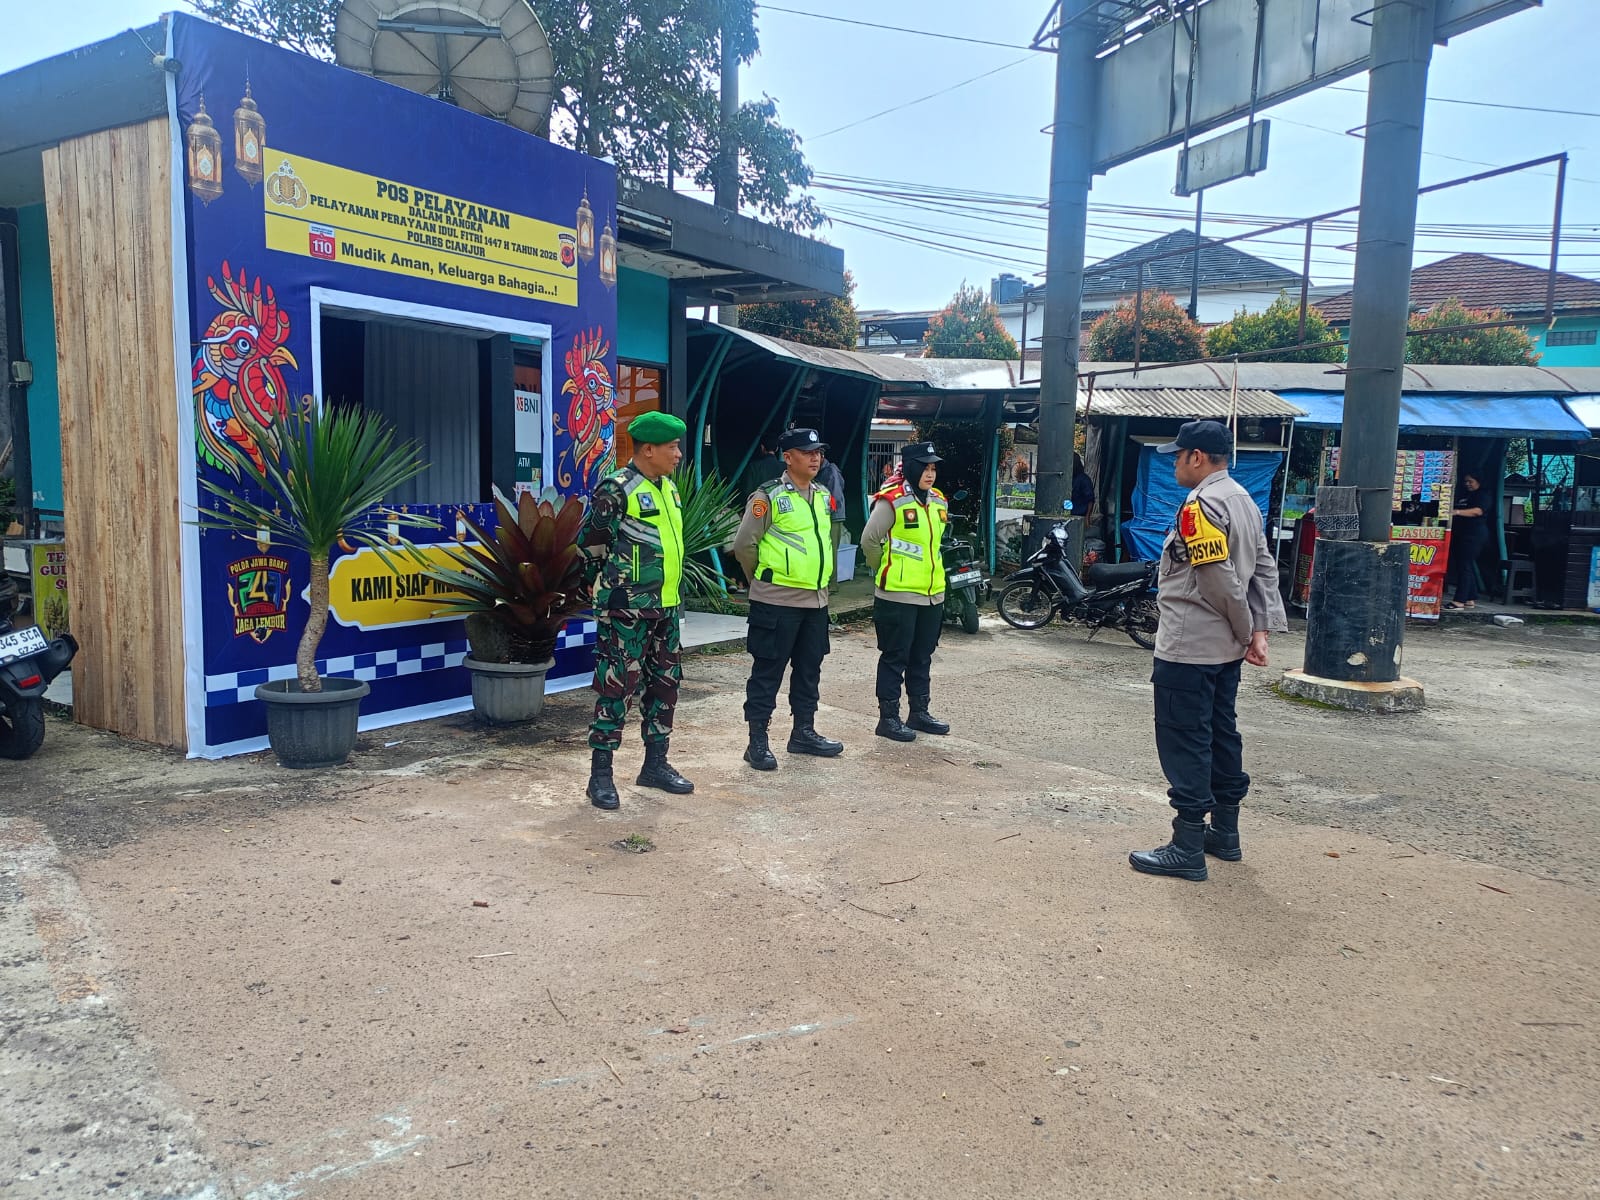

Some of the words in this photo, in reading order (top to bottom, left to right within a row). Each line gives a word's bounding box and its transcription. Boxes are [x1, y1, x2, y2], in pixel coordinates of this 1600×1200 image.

[377, 180, 409, 203] POS
[414, 190, 510, 229] PELAYANAN
[310, 194, 379, 220] PELAYANAN
[381, 211, 437, 233] PERAYAAN
[438, 224, 458, 239] IDUL
[460, 230, 483, 244] FITRI
[484, 236, 502, 249] 1447
[504, 240, 510, 251] H
[511, 242, 539, 257] TAHUN
[540, 249, 558, 261] 2026
[408, 206, 444, 223] DALAM
[446, 215, 483, 233] RANGKA
[312, 239, 332, 255] 110
[407, 230, 444, 248] POLRES
[445, 239, 486, 257] CIANJUR
[341, 241, 386, 263] Mudik
[391, 252, 434, 275] Aman,
[438, 261, 494, 286] Keluarga
[498, 274, 558, 296] Bahagia...!
[524, 397, 539, 414] BNI
[518, 457, 530, 467] ATM
[1399, 528, 1441, 539] JASUKE
[46, 552, 66, 562] TE
[230, 560, 250, 574] POLDA
[250, 557, 268, 569] JAWA
[268, 558, 288, 571] BARAT
[1409, 544, 1437, 566] AN
[351, 576, 392, 602] KAMI
[396, 574, 429, 598] SIAP
[20, 628, 40, 642] SCA
[235, 618, 254, 635] JAGA
[255, 614, 286, 629] LEMBUR
